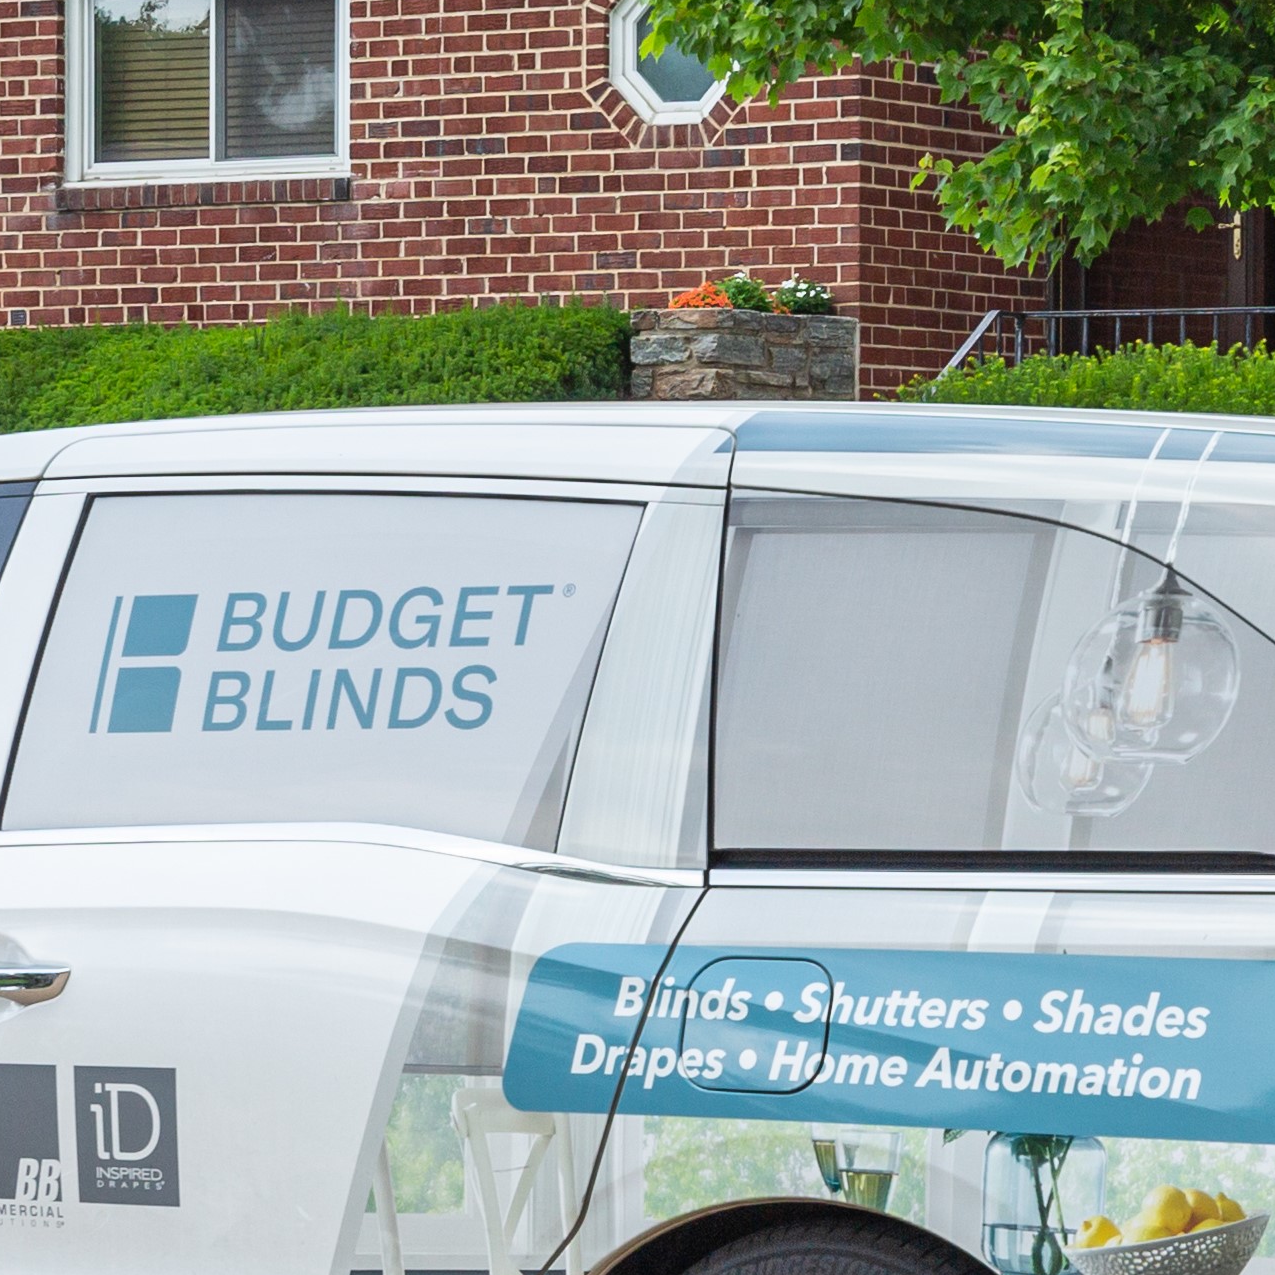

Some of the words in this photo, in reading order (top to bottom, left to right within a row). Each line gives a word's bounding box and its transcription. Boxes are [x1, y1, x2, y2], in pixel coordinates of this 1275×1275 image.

[201, 664, 498, 732] BLINDS
[613, 977, 751, 1023] Blinds
[793, 982, 990, 1030] Shutters
[1033, 990, 1210, 1040] Shades
[571, 1034, 726, 1090] Drapes
[768, 1040, 908, 1088] Home
[914, 1047, 1202, 1101] Automation
[15, 1157, 63, 1203] BB
[96, 1166, 163, 1182] INSPIRED
